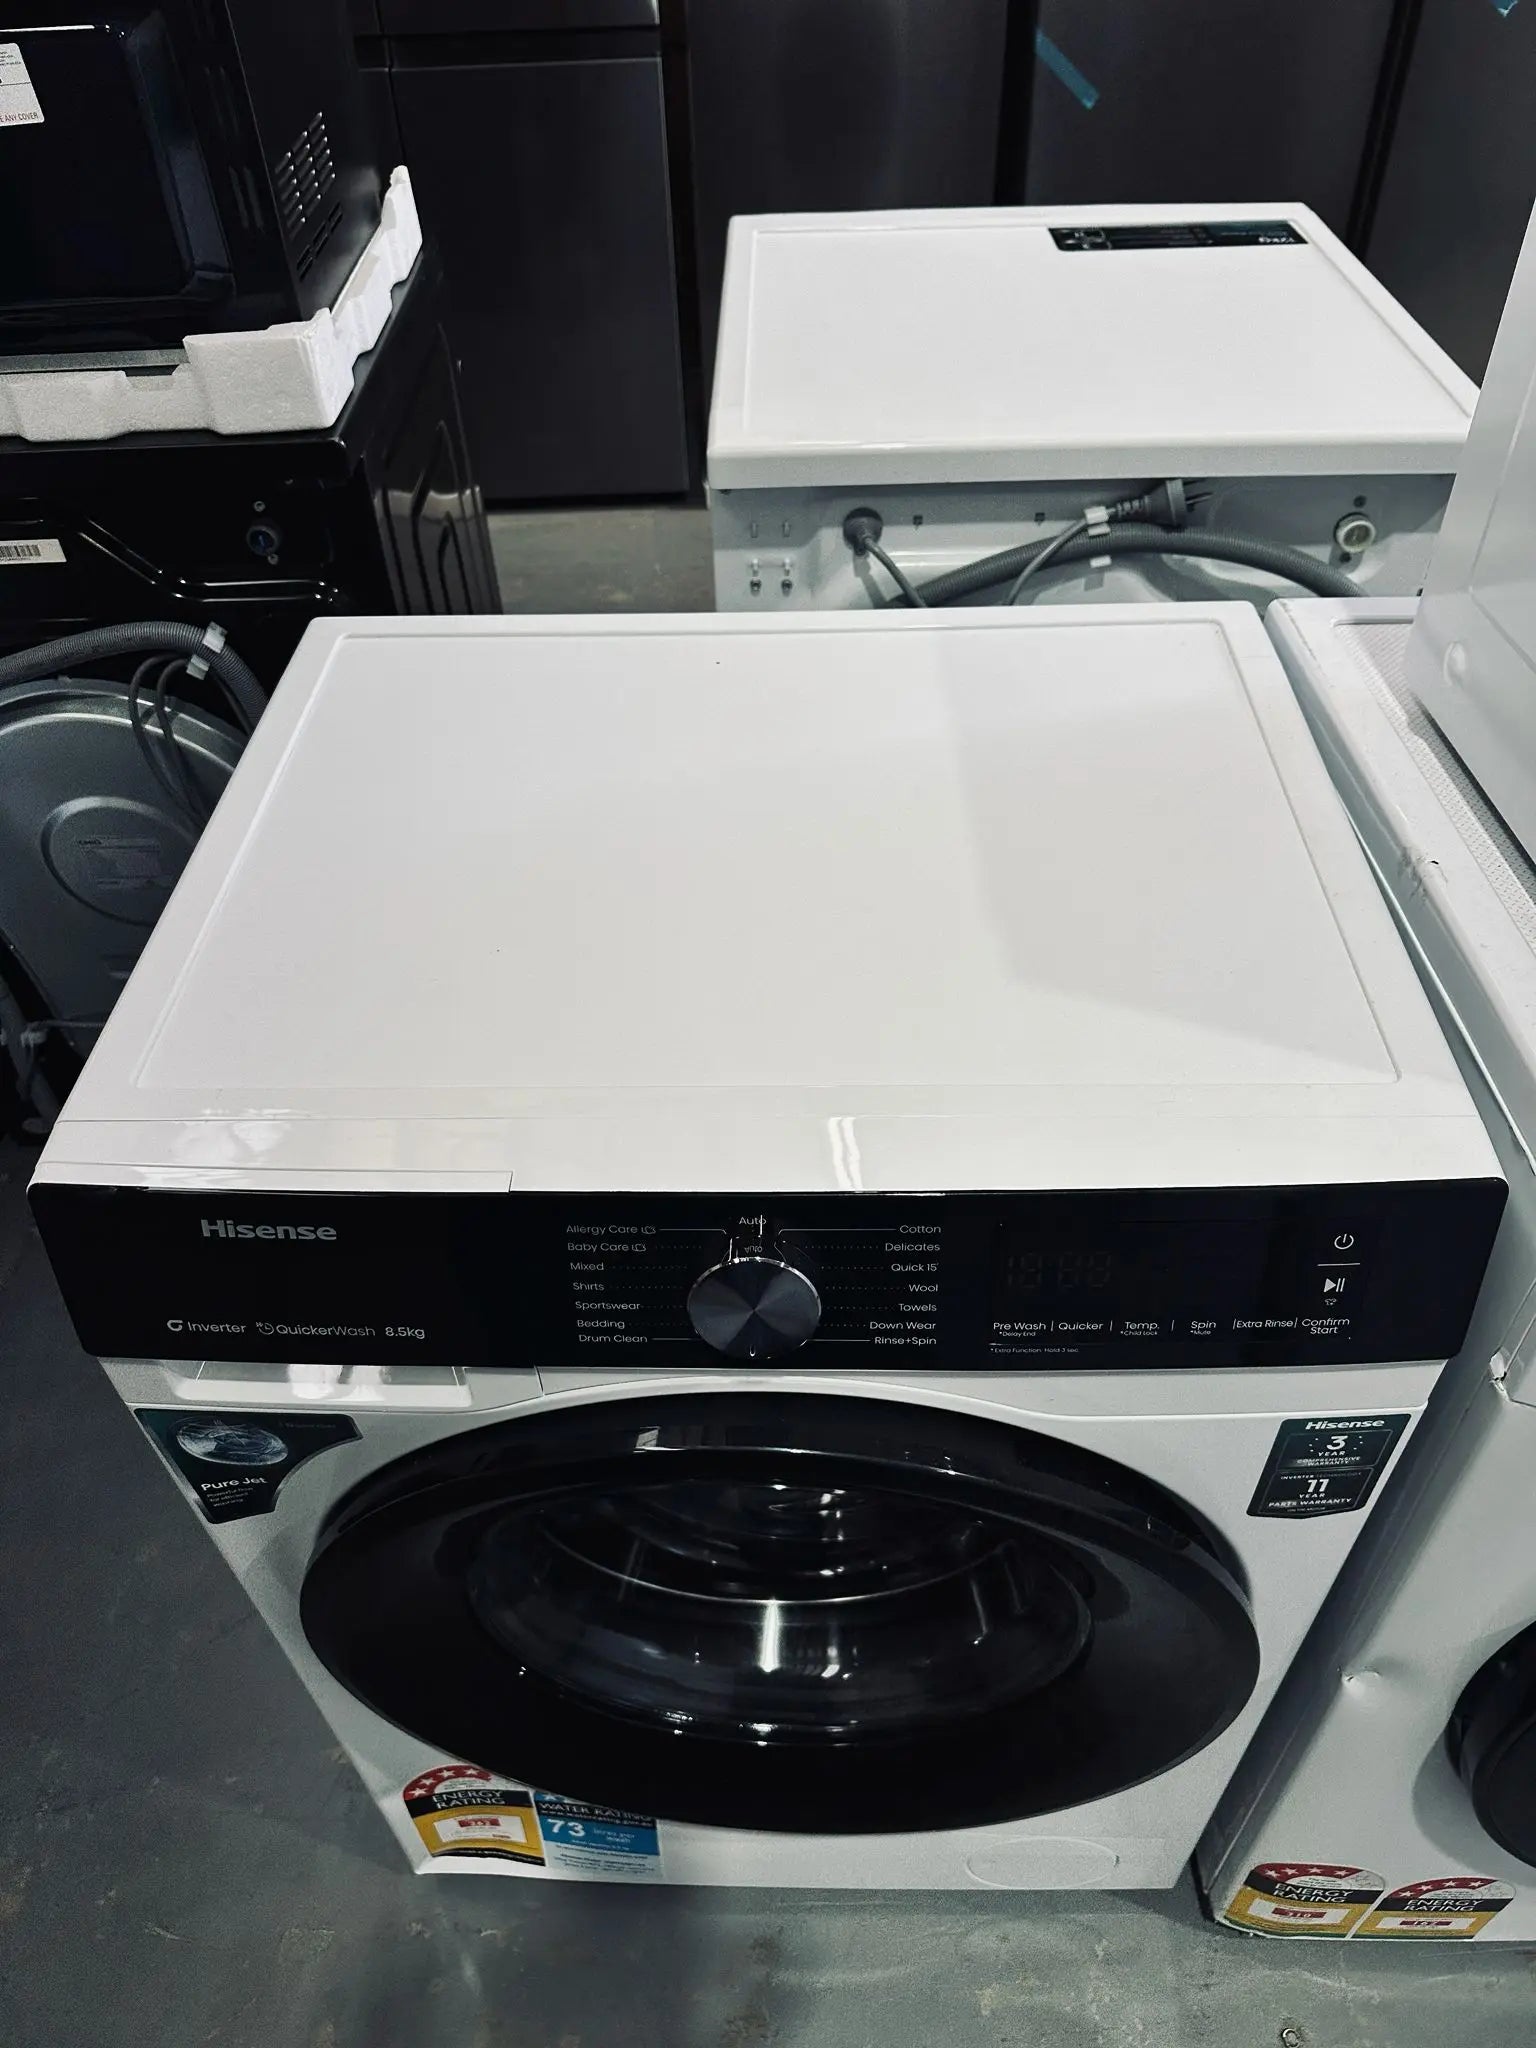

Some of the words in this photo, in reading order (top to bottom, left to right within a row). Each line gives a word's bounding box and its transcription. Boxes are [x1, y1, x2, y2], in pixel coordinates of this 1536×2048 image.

[18, 112, 39, 120] COVER
[739, 1216, 767, 1225] Auto
[201, 1218, 338, 1241] Hisense
[566, 1224, 606, 1236] Allergy
[608, 1224, 638, 1234] Care
[899, 1224, 942, 1234] Cotton
[567, 1241, 599, 1252] Baby
[601, 1241, 630, 1252] Care
[885, 1242, 941, 1252] Delicates
[569, 1261, 605, 1271] Mixed
[891, 1262, 925, 1272] Quick
[572, 1281, 605, 1291] Shirts
[908, 1283, 939, 1293] Wool
[575, 1300, 641, 1311] Sportswear
[898, 1303, 938, 1312] Towels
[576, 1319, 626, 1330] Bedding
[869, 1321, 904, 1330] Down
[905, 1321, 937, 1330] Wear
[993, 1321, 1012, 1331] Pre
[1013, 1321, 1047, 1331] Wash
[1058, 1321, 1104, 1331] Quicker
[1124, 1320, 1160, 1332] Temp.
[1190, 1320, 1217, 1330] Spin
[1236, 1319, 1263, 1329] Extra
[1264, 1319, 1294, 1328] Rinse
[1301, 1317, 1350, 1327] Confirm
[187, 1320, 247, 1334] Inverter
[276, 1323, 376, 1337] QuickerWash
[384, 1326, 426, 1340] 8.5kg
[1310, 1326, 1338, 1335] Start
[578, 1333, 611, 1343] Drum
[613, 1333, 648, 1343] Clean
[874, 1335, 937, 1347] Rinse+Spin
[1305, 1419, 1385, 1430] Hisense
[1326, 1435, 1349, 1450] 3
[1296, 1456, 1361, 1464] COMPREHENSIVE
[200, 1479, 240, 1491] Pure
[1299, 1497, 1353, 1506] WARRANTY
[432, 1789, 504, 1803] ENERGY
[436, 1796, 506, 1810] RATING
[539, 1802, 590, 1814] WATER
[547, 1818, 586, 1837] 73
[1275, 1882, 1354, 1897] ENERGY
[1273, 1889, 1347, 1903] RATING
